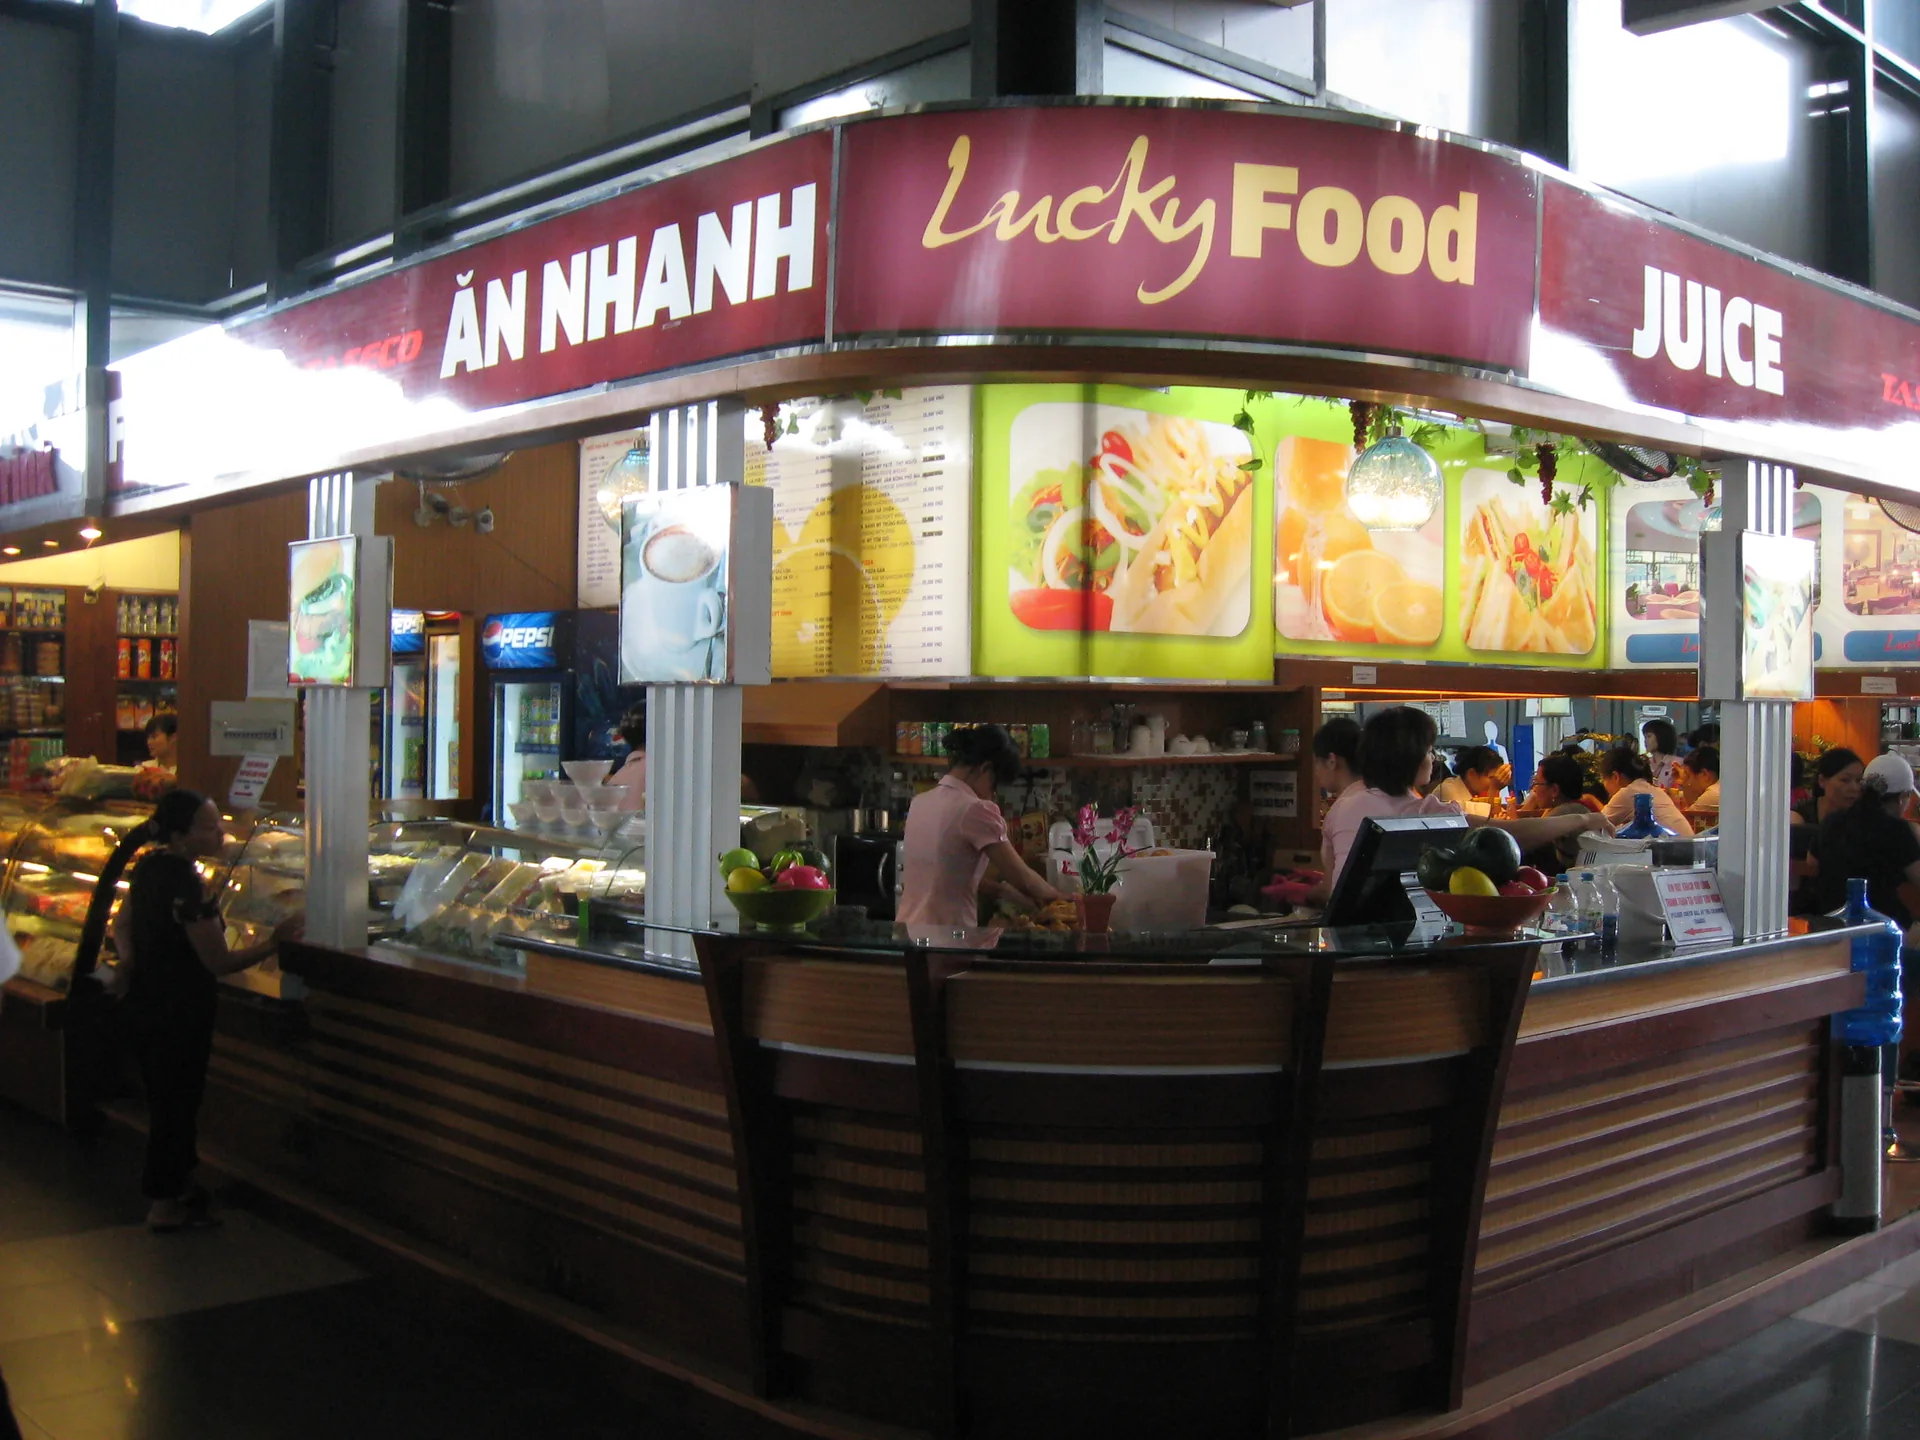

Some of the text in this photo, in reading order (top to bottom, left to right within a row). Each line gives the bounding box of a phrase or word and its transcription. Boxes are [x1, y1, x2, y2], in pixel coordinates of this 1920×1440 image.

[440, 182, 816, 379] ĂN NHANH
[922, 134, 1216, 304] Lucky
[1632, 264, 1785, 397] JUICE
[501, 627, 555, 648] PEPSI
